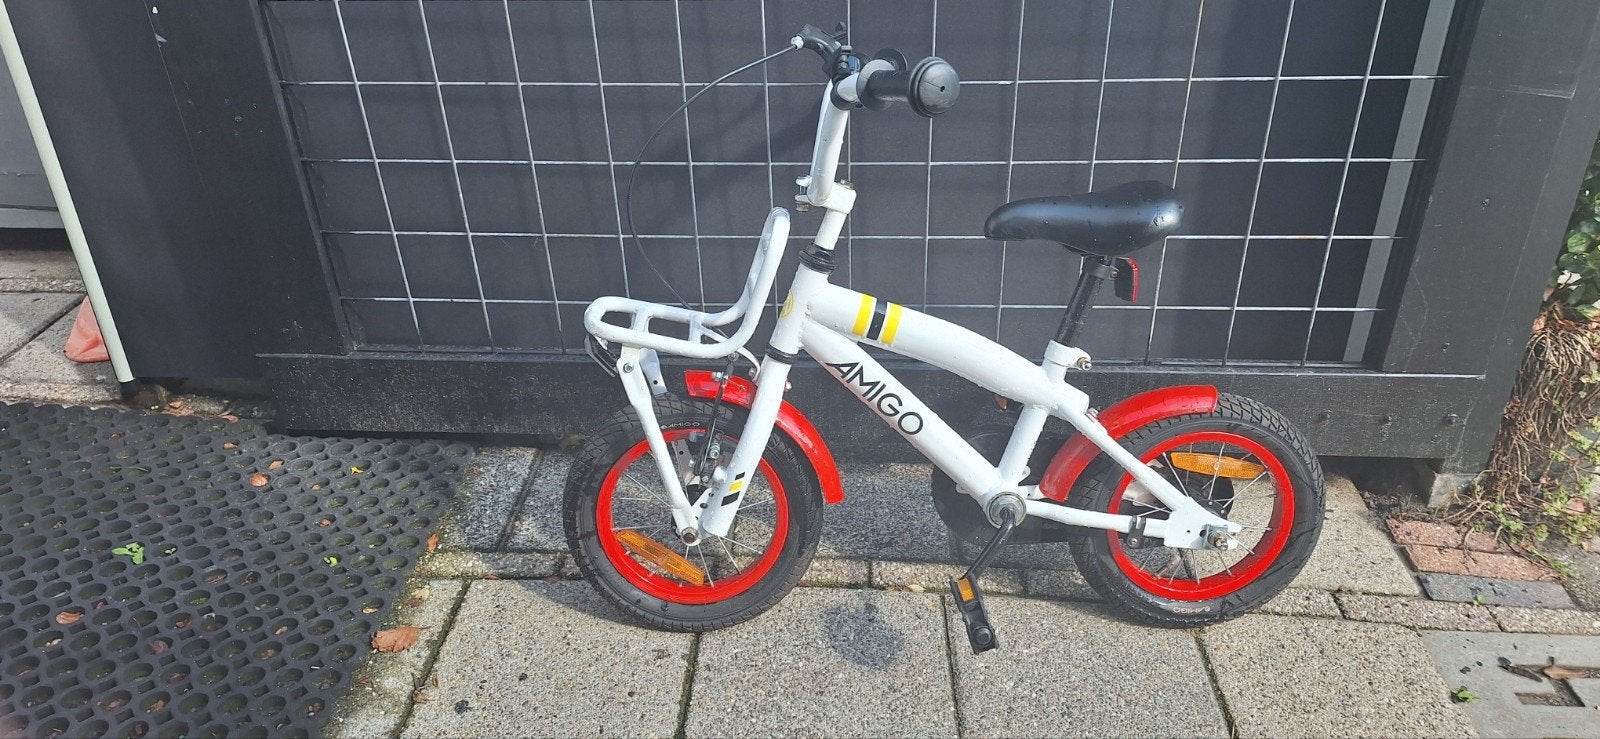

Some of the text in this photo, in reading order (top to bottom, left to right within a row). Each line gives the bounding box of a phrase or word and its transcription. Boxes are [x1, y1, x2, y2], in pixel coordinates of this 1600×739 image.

[824, 361, 924, 436] AMIGO
[667, 421, 701, 429] AMIGO
[1172, 605, 1206, 614] AMIGO
